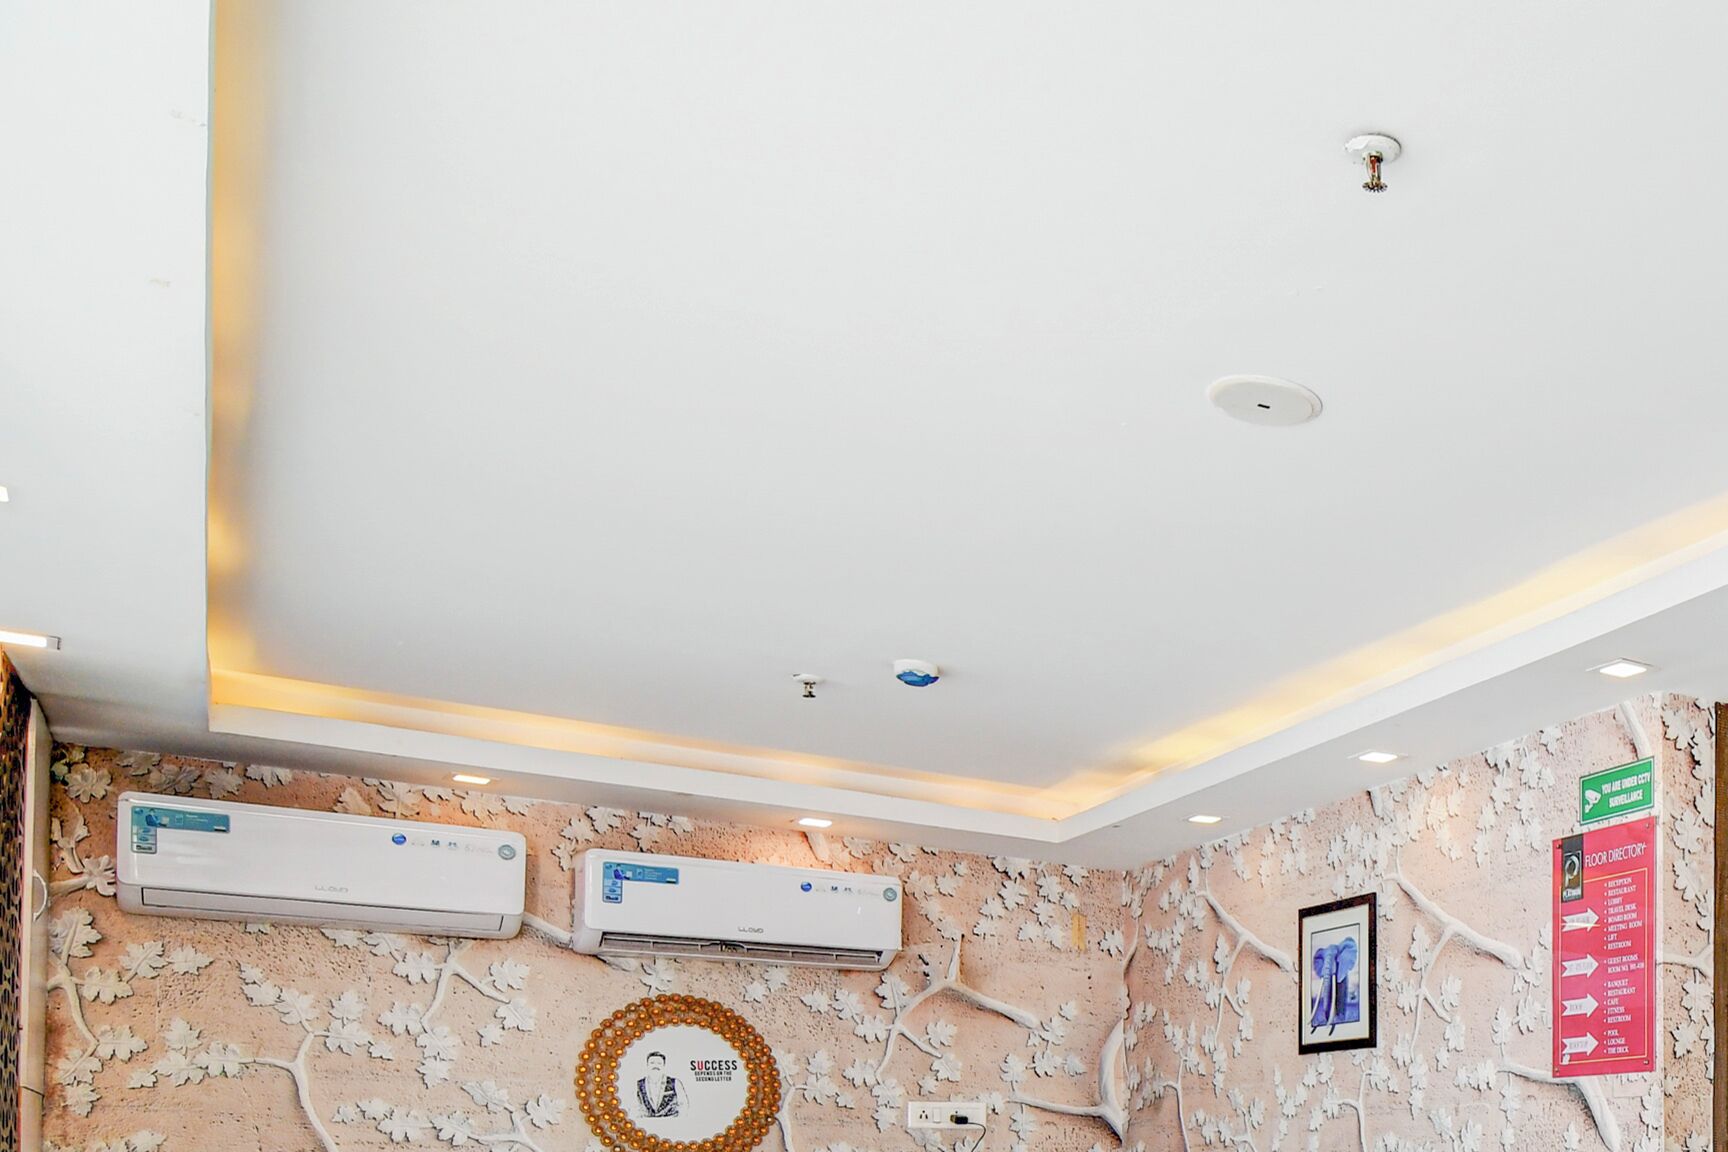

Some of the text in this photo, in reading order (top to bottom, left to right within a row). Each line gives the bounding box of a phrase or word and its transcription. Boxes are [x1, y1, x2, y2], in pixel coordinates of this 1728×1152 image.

[1602, 772, 1650, 795] YOU ARE UNDER CCTV
[1609, 789, 1643, 808] SURVEILLANCE
[1585, 842, 1647, 868] FLOOR DIRECTORY
[1607, 876, 1633, 888] RECEPTION
[1607, 884, 1637, 896] RESTAURANT
[1607, 896, 1623, 906] LOBBY
[1607, 903, 1637, 915] TRAVEL DESK
[1624, 912, 1637, 921] ROOM
[737, 926, 764, 934] LLOYD
[1607, 920, 1643, 932] MEETING ROOM
[1607, 933, 1617, 941] LIFT
[1607, 940, 1632, 951] RESTROOM
[1607, 987, 1636, 997] RESTAURANT
[1607, 1014, 1632, 1024] RESTROOM
[1607, 1037, 1625, 1045] LOUNGE
[690, 1060, 738, 1071] SUCCESS
